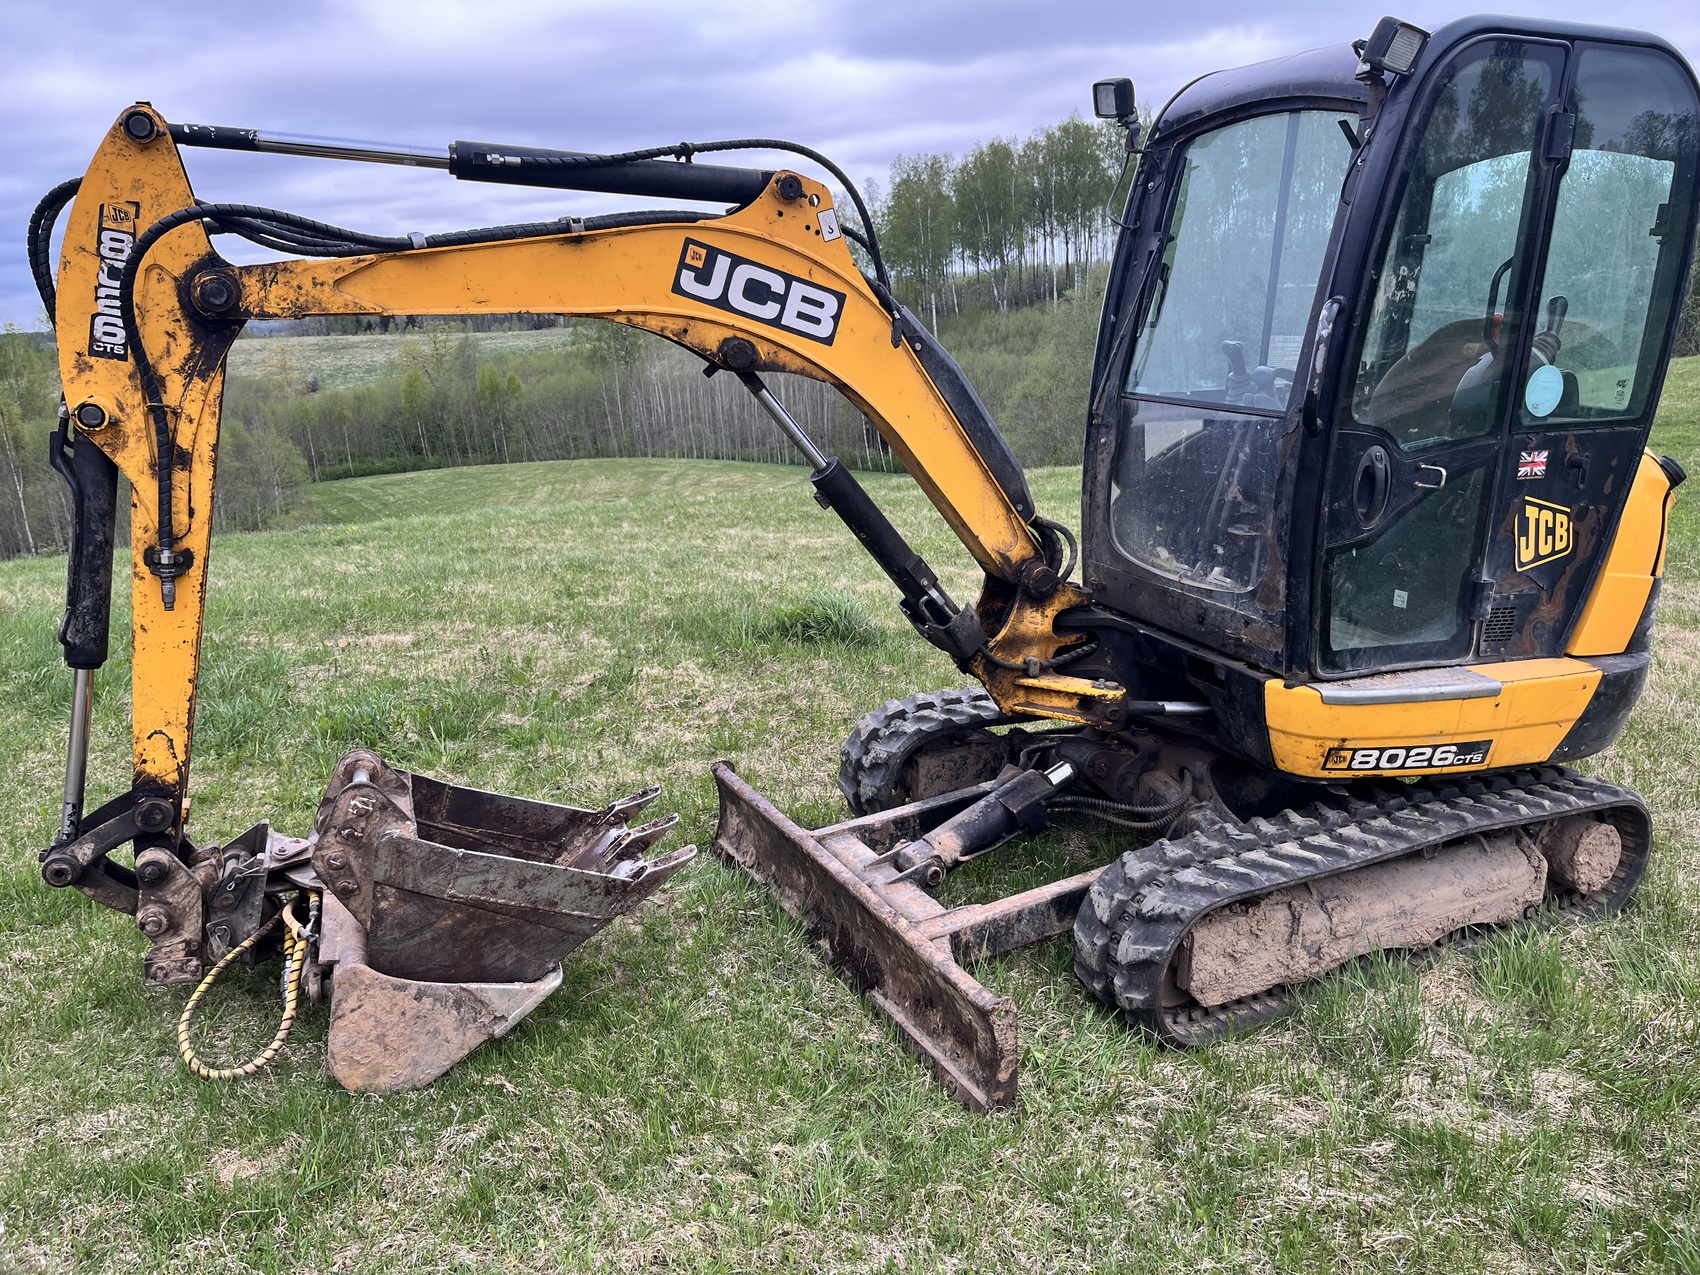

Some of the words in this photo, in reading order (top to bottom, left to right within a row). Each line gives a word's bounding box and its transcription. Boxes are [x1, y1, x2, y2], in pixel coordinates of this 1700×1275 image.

[111, 206, 130, 223] JCB
[679, 254, 839, 338] JCB
[93, 342, 125, 355] CTS
[1519, 504, 1568, 563] JCB
[1351, 746, 1458, 769] 8026
[1453, 754, 1483, 765] CTS
